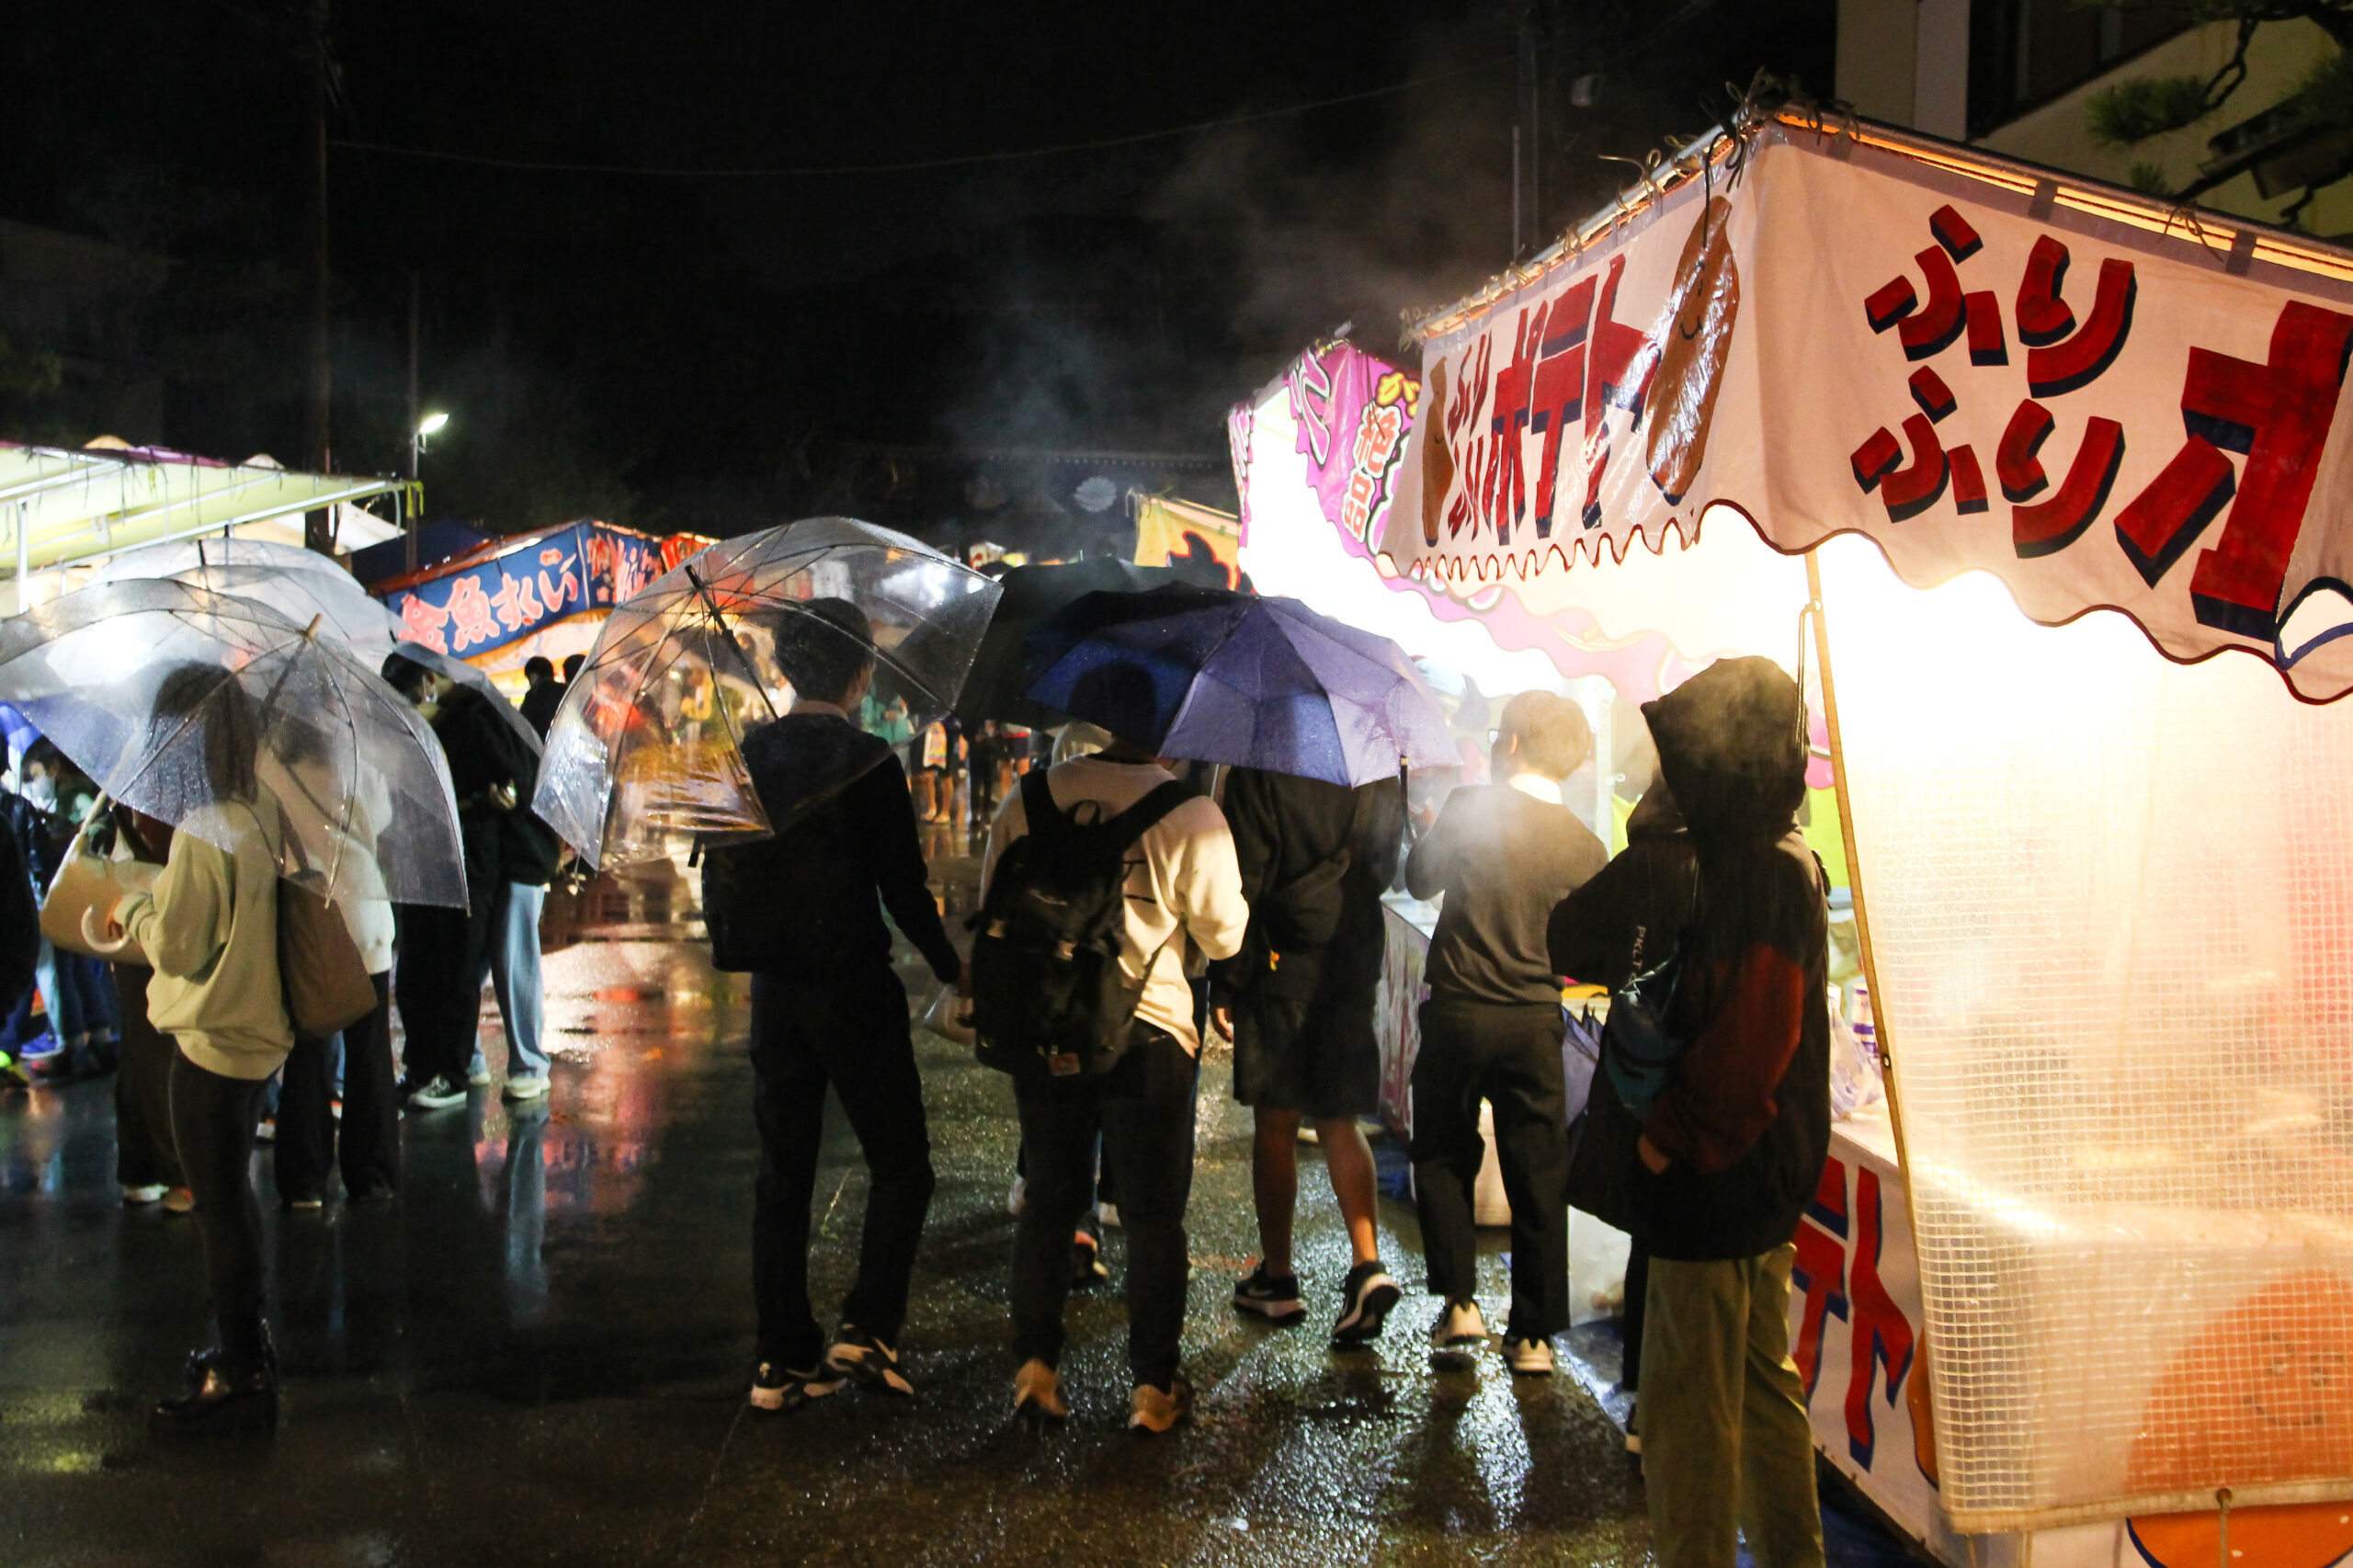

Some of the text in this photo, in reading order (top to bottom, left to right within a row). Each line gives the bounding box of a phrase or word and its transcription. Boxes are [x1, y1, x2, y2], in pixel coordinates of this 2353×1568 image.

[399, 568, 578, 655] 金魚すくい
